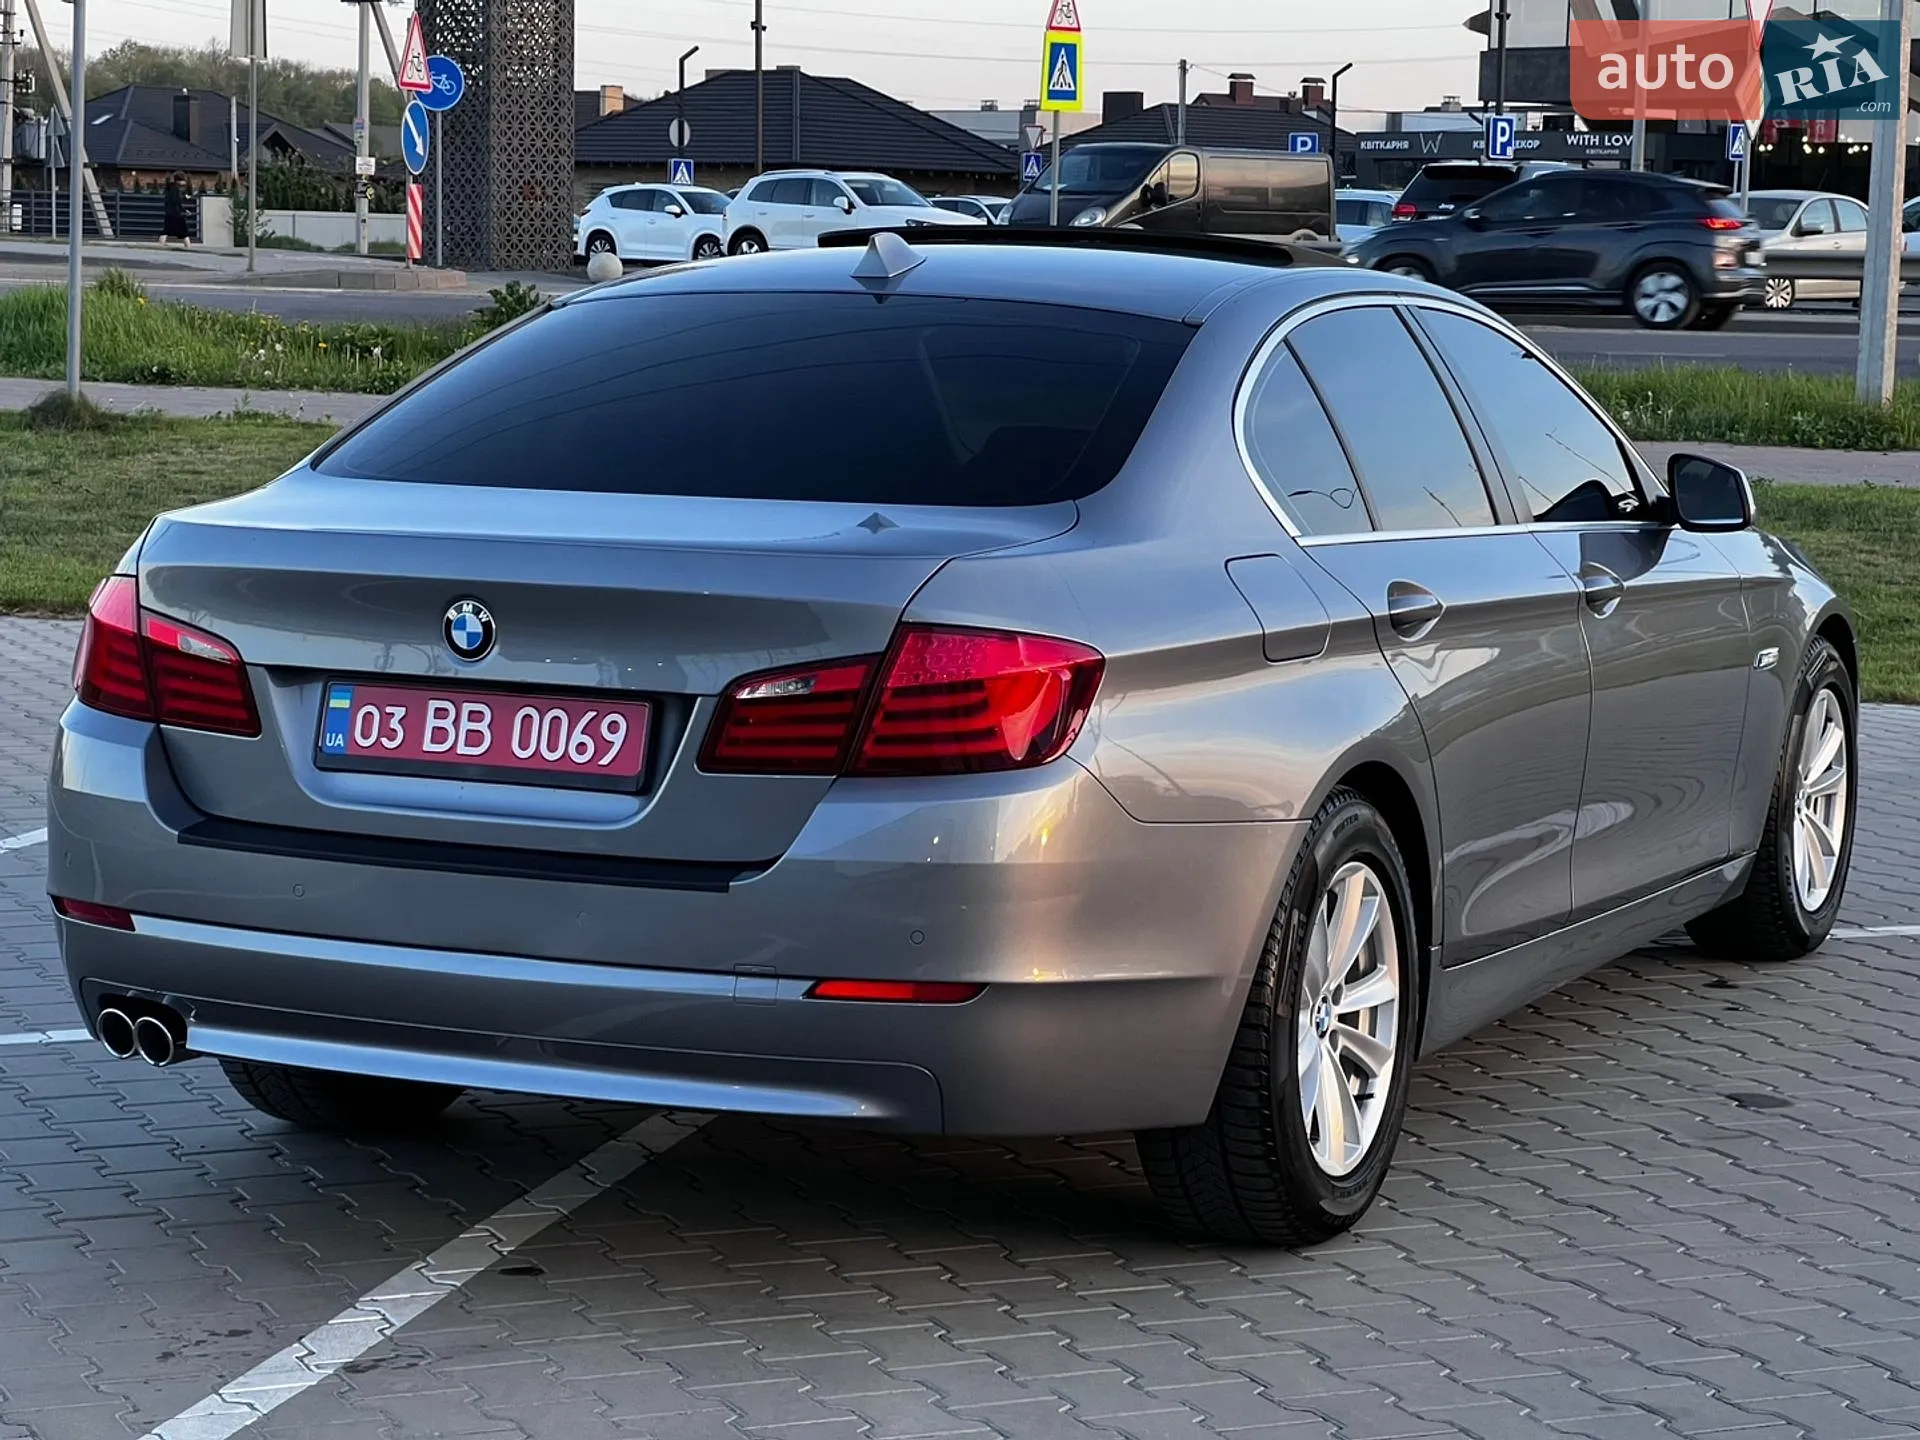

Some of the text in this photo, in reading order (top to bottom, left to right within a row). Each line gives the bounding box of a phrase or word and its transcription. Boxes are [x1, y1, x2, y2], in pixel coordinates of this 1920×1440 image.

[1296, 136, 1312, 152] P
[1496, 120, 1510, 155] P
[1513, 139, 1541, 149] ЕКОР
[1566, 134, 1633, 146] WITH LOV
[447, 603, 490, 622] BMW
[325, 732, 345, 748] UA
[354, 699, 628, 766] 03 BB 0069
